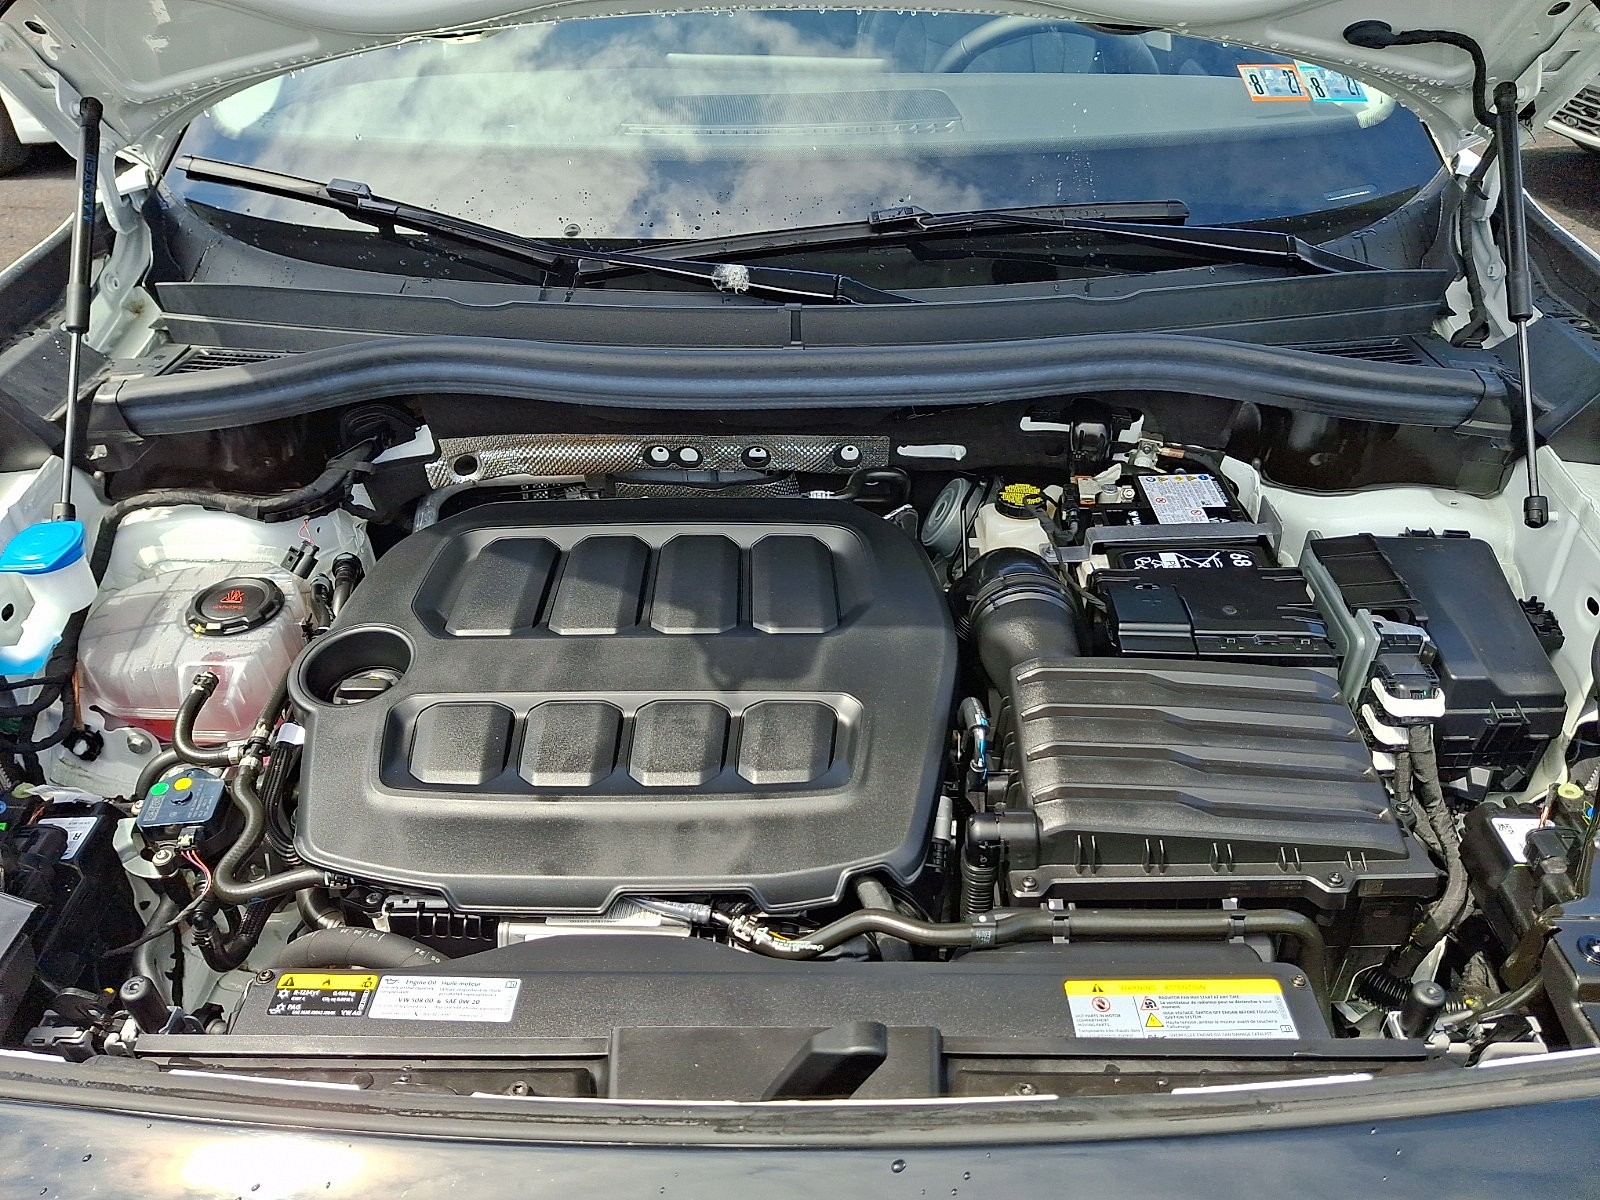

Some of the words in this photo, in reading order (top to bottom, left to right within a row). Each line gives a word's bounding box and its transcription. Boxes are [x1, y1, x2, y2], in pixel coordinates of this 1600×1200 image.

[1250, 74, 1265, 95] 8
[1282, 70, 1301, 95] 27
[1310, 77, 1326, 98] 8
[1230, 553, 1252, 567] 68
